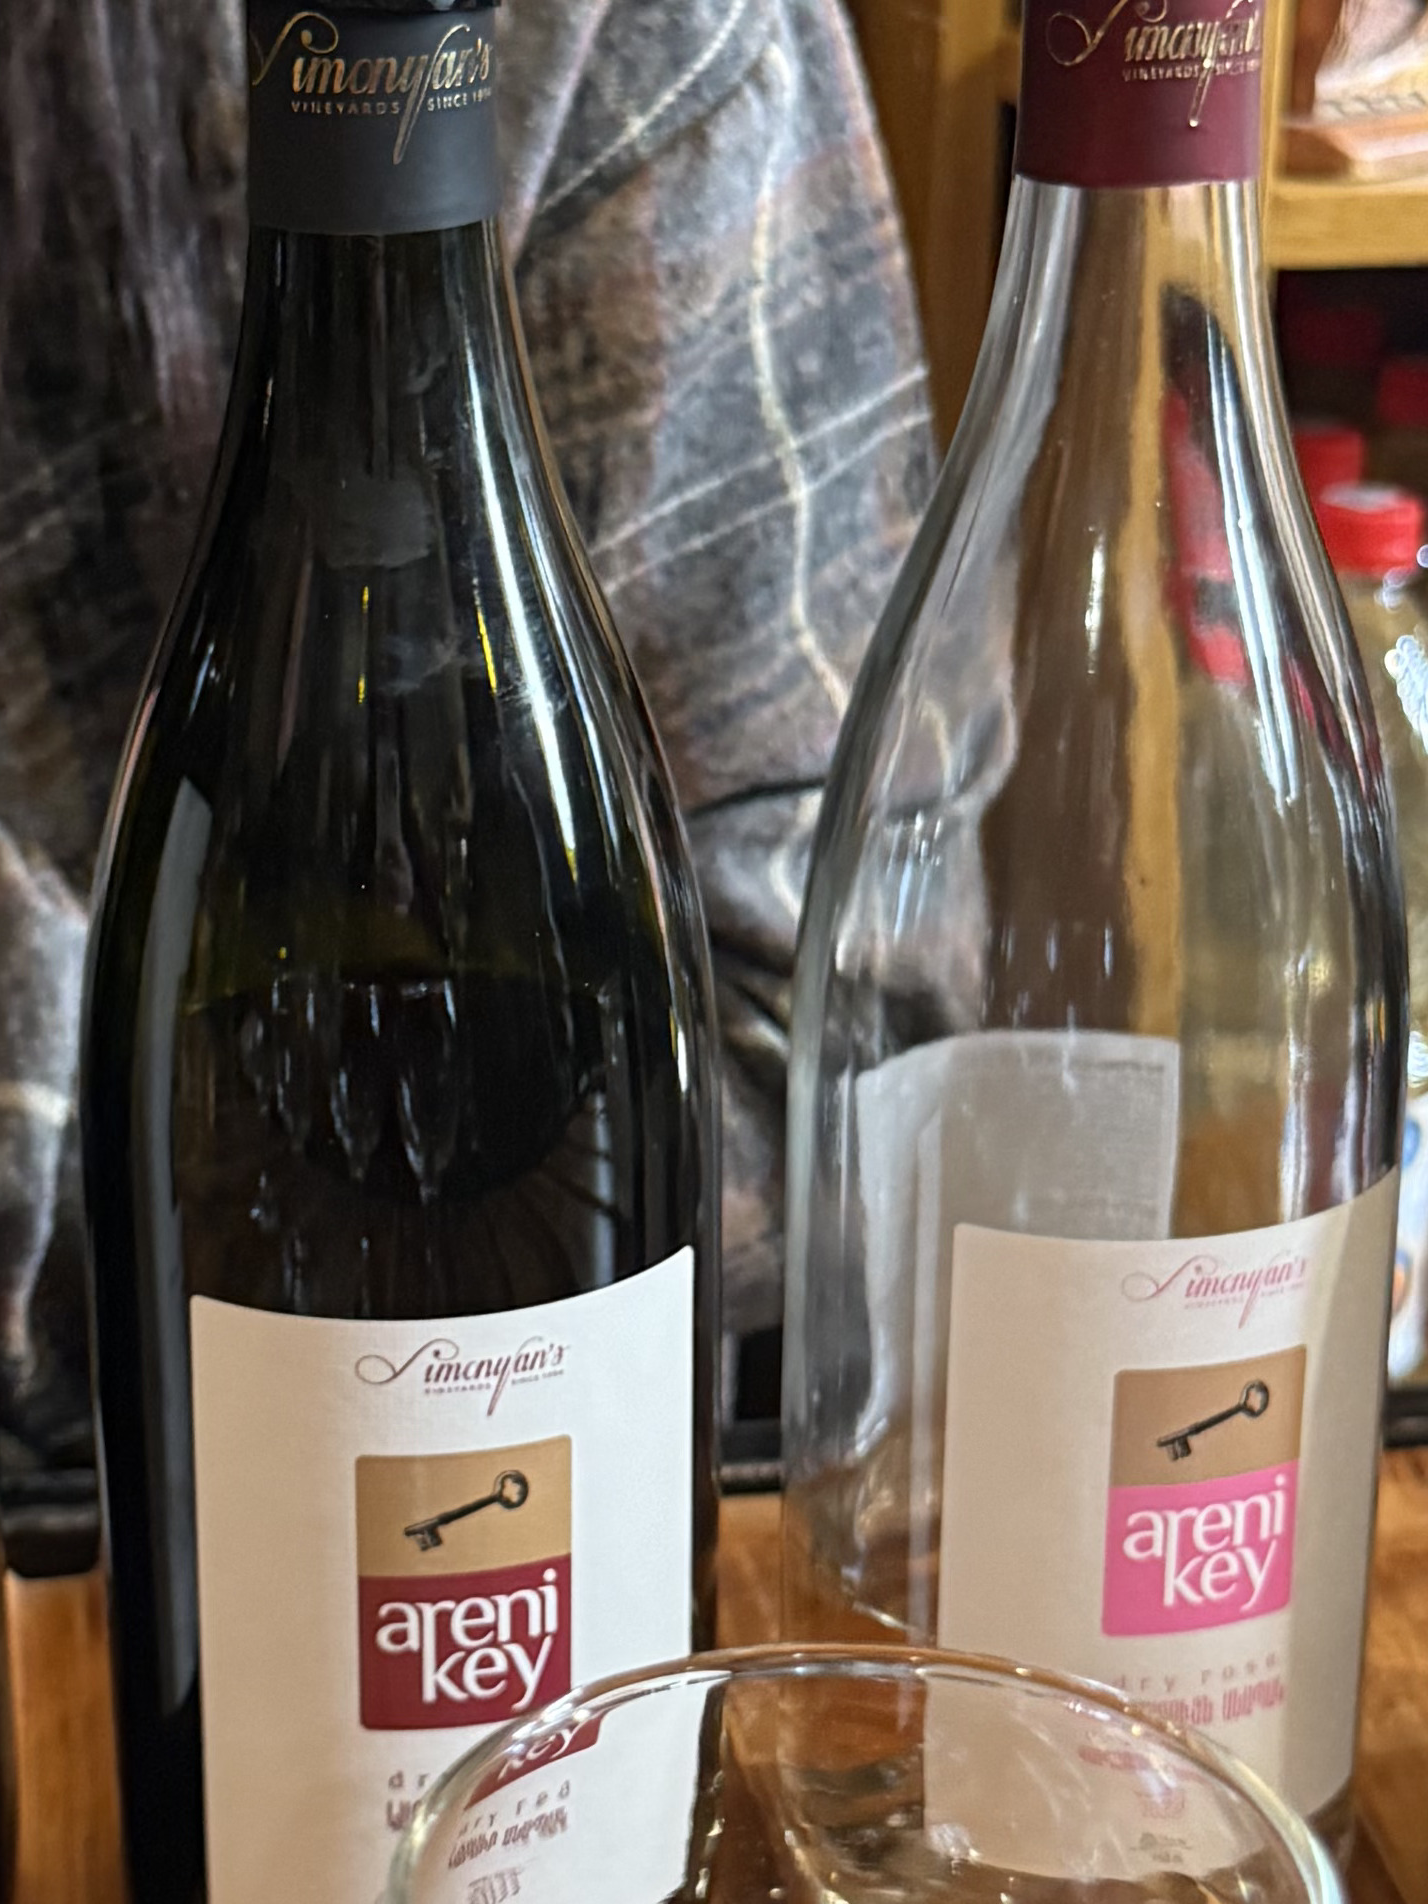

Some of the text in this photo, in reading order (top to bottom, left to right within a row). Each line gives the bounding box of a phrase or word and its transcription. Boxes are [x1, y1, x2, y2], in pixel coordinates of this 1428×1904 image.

[291, 101, 401, 115] VINEYARDS
[427, 93, 468, 112] SINCE
[1123, 1475, 1287, 1562] areni
[376, 1569, 559, 1654] areni
[1163, 1537, 1277, 1612] key
[421, 1636, 553, 1713] key
[388, 1770, 430, 1789] dr
